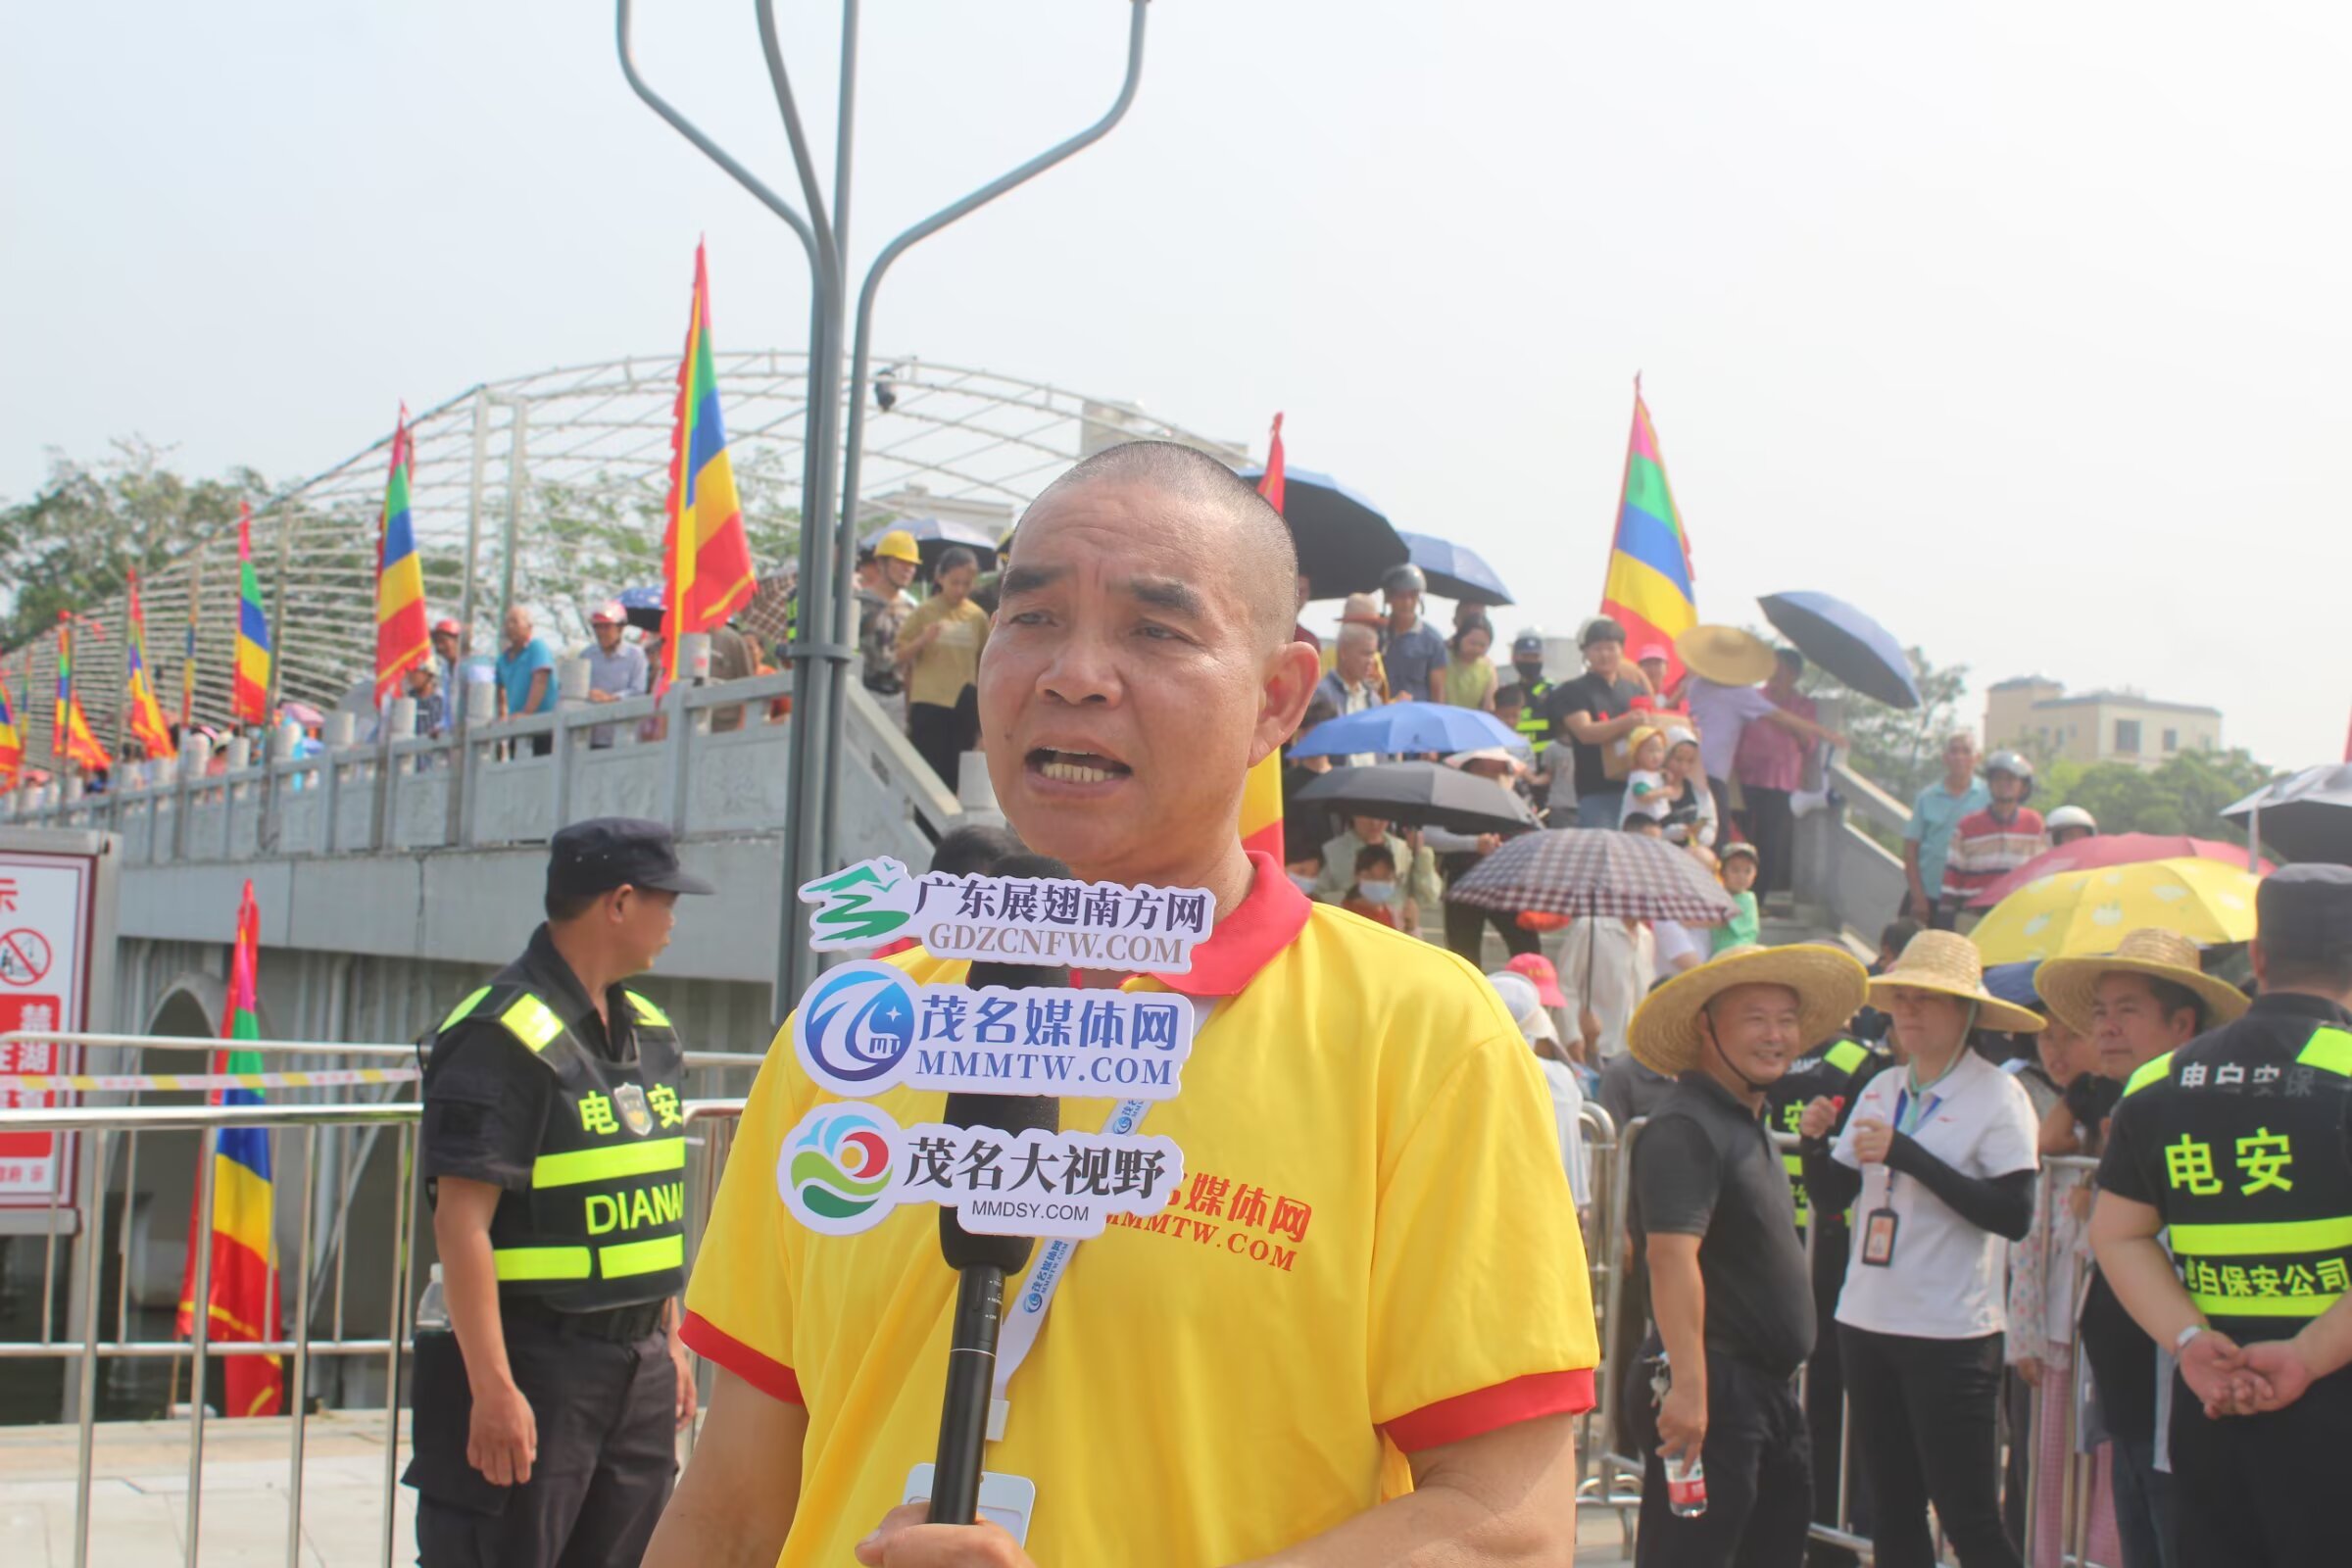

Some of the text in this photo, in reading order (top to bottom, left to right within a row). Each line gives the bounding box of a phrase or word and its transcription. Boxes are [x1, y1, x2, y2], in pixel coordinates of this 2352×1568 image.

[914, 877, 1206, 934] 广东展翅南方网
[929, 923, 1185, 964] GDZCNFW.COM
[919, 995, 1179, 1052] 茂名媒体网
[915, 1050, 1173, 1086] MMMTW.COM
[904, 1136, 1166, 1200] 茂名大视野
[971, 1200, 1090, 1222] MMDSY.COM
